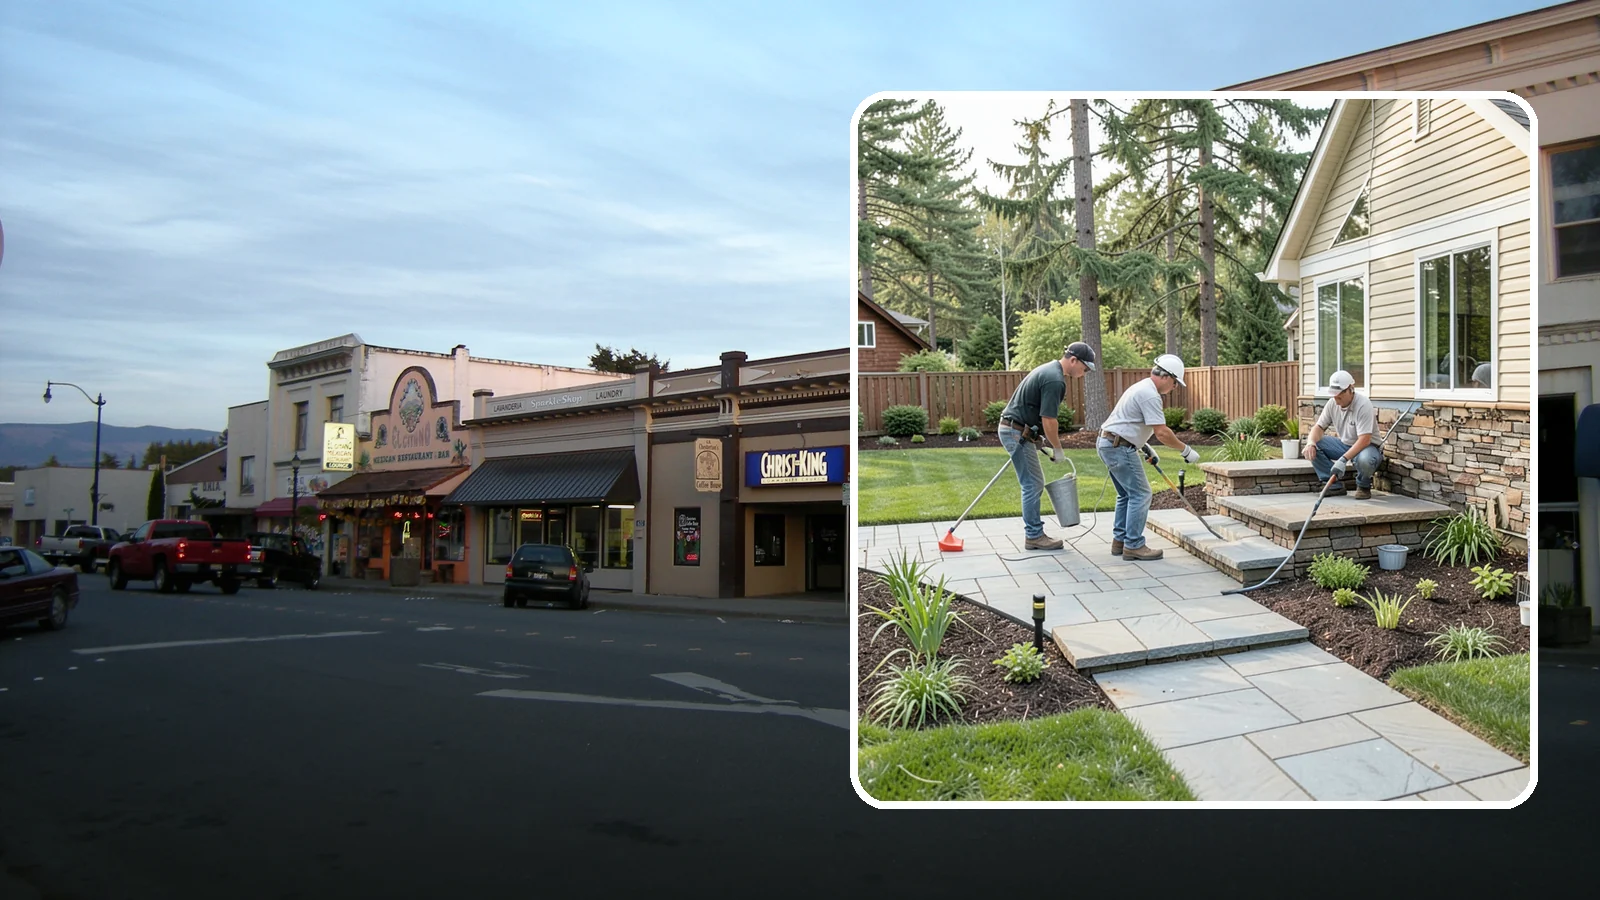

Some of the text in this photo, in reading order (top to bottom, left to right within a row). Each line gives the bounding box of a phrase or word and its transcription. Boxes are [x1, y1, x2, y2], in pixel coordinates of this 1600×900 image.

[561, 394, 583, 404] Shop
[595, 389, 623, 400] LAUNDRY
[493, 402, 522, 412] LAVANDERIA
[374, 454, 396, 464] MEXICAN
[397, 451, 433, 462] RESTAURANT
[437, 450, 450, 459] BAR
[761, 449, 827, 478] CHRIST KING
